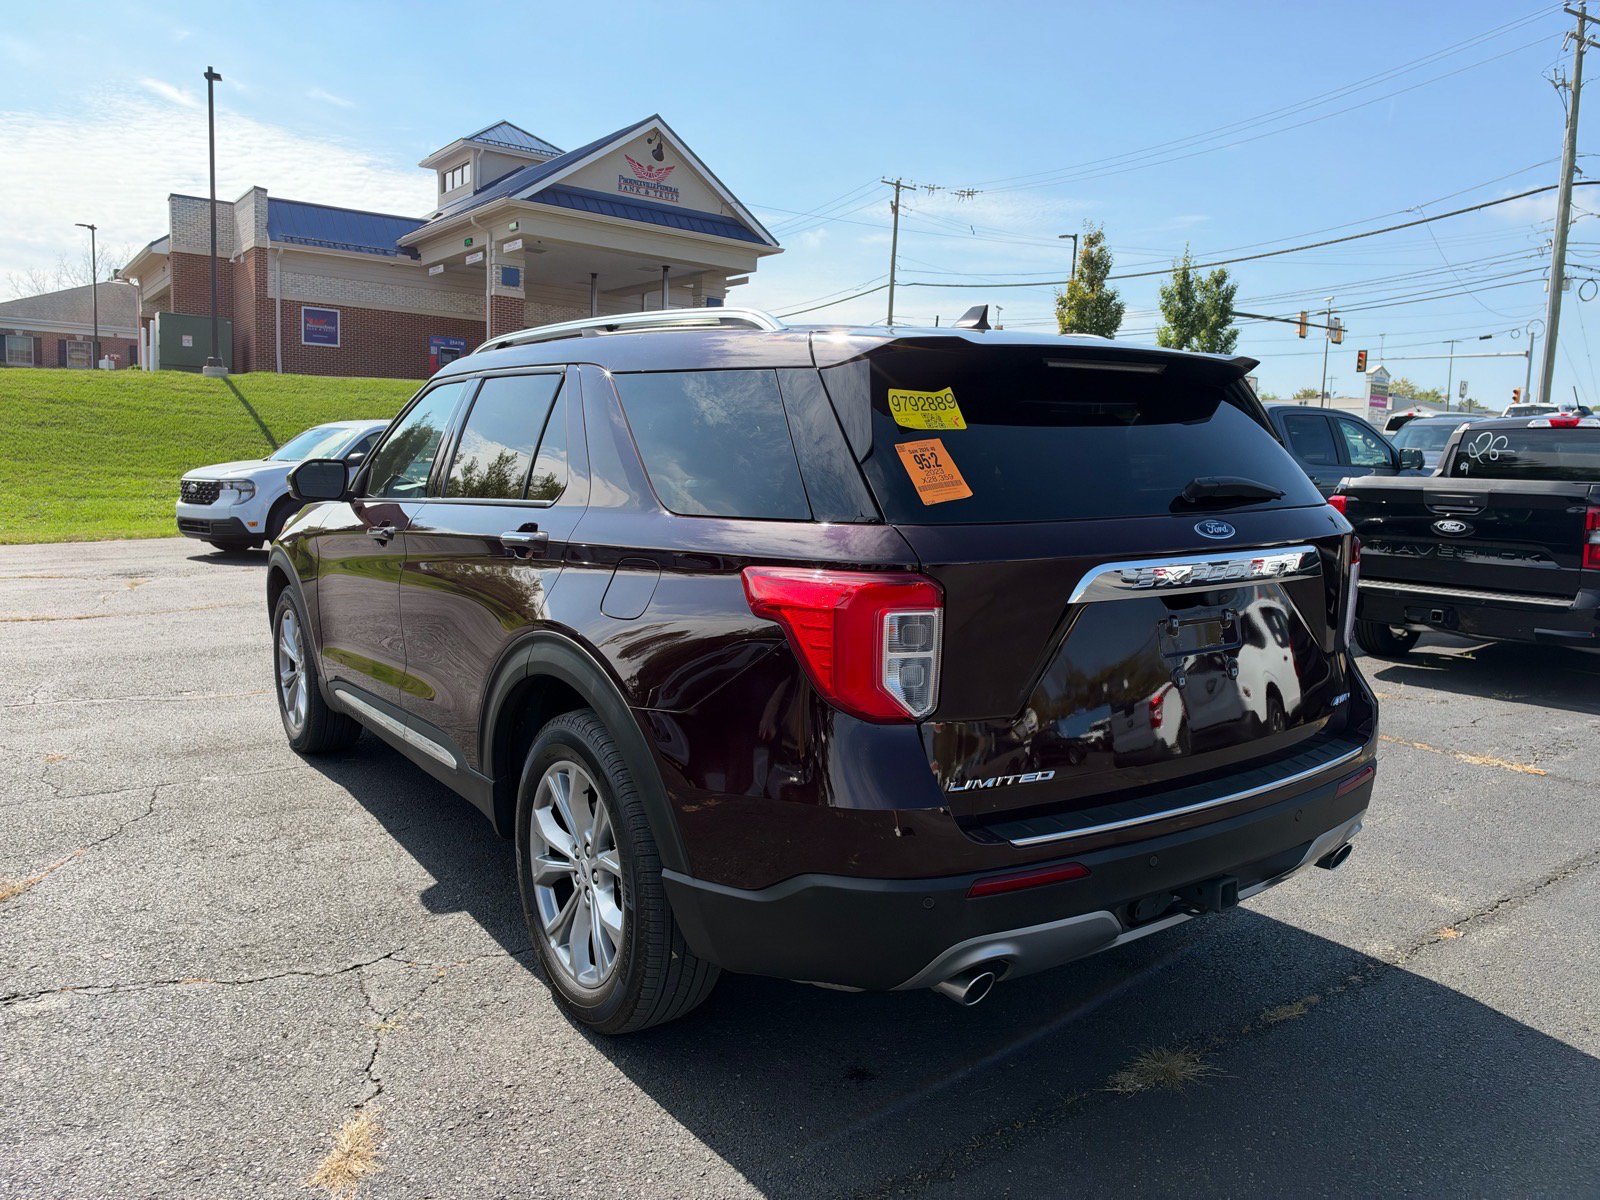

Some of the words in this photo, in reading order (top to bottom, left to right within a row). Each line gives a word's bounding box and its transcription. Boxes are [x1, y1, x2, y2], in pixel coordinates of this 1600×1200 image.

[618, 184, 640, 195] BANK
[653, 190, 679, 201] TRUST
[891, 392, 956, 412] 9792889
[925, 468, 945, 476] 2023
[1131, 559, 1299, 589] EXPLORER
[948, 770, 1056, 792] LIMITED
